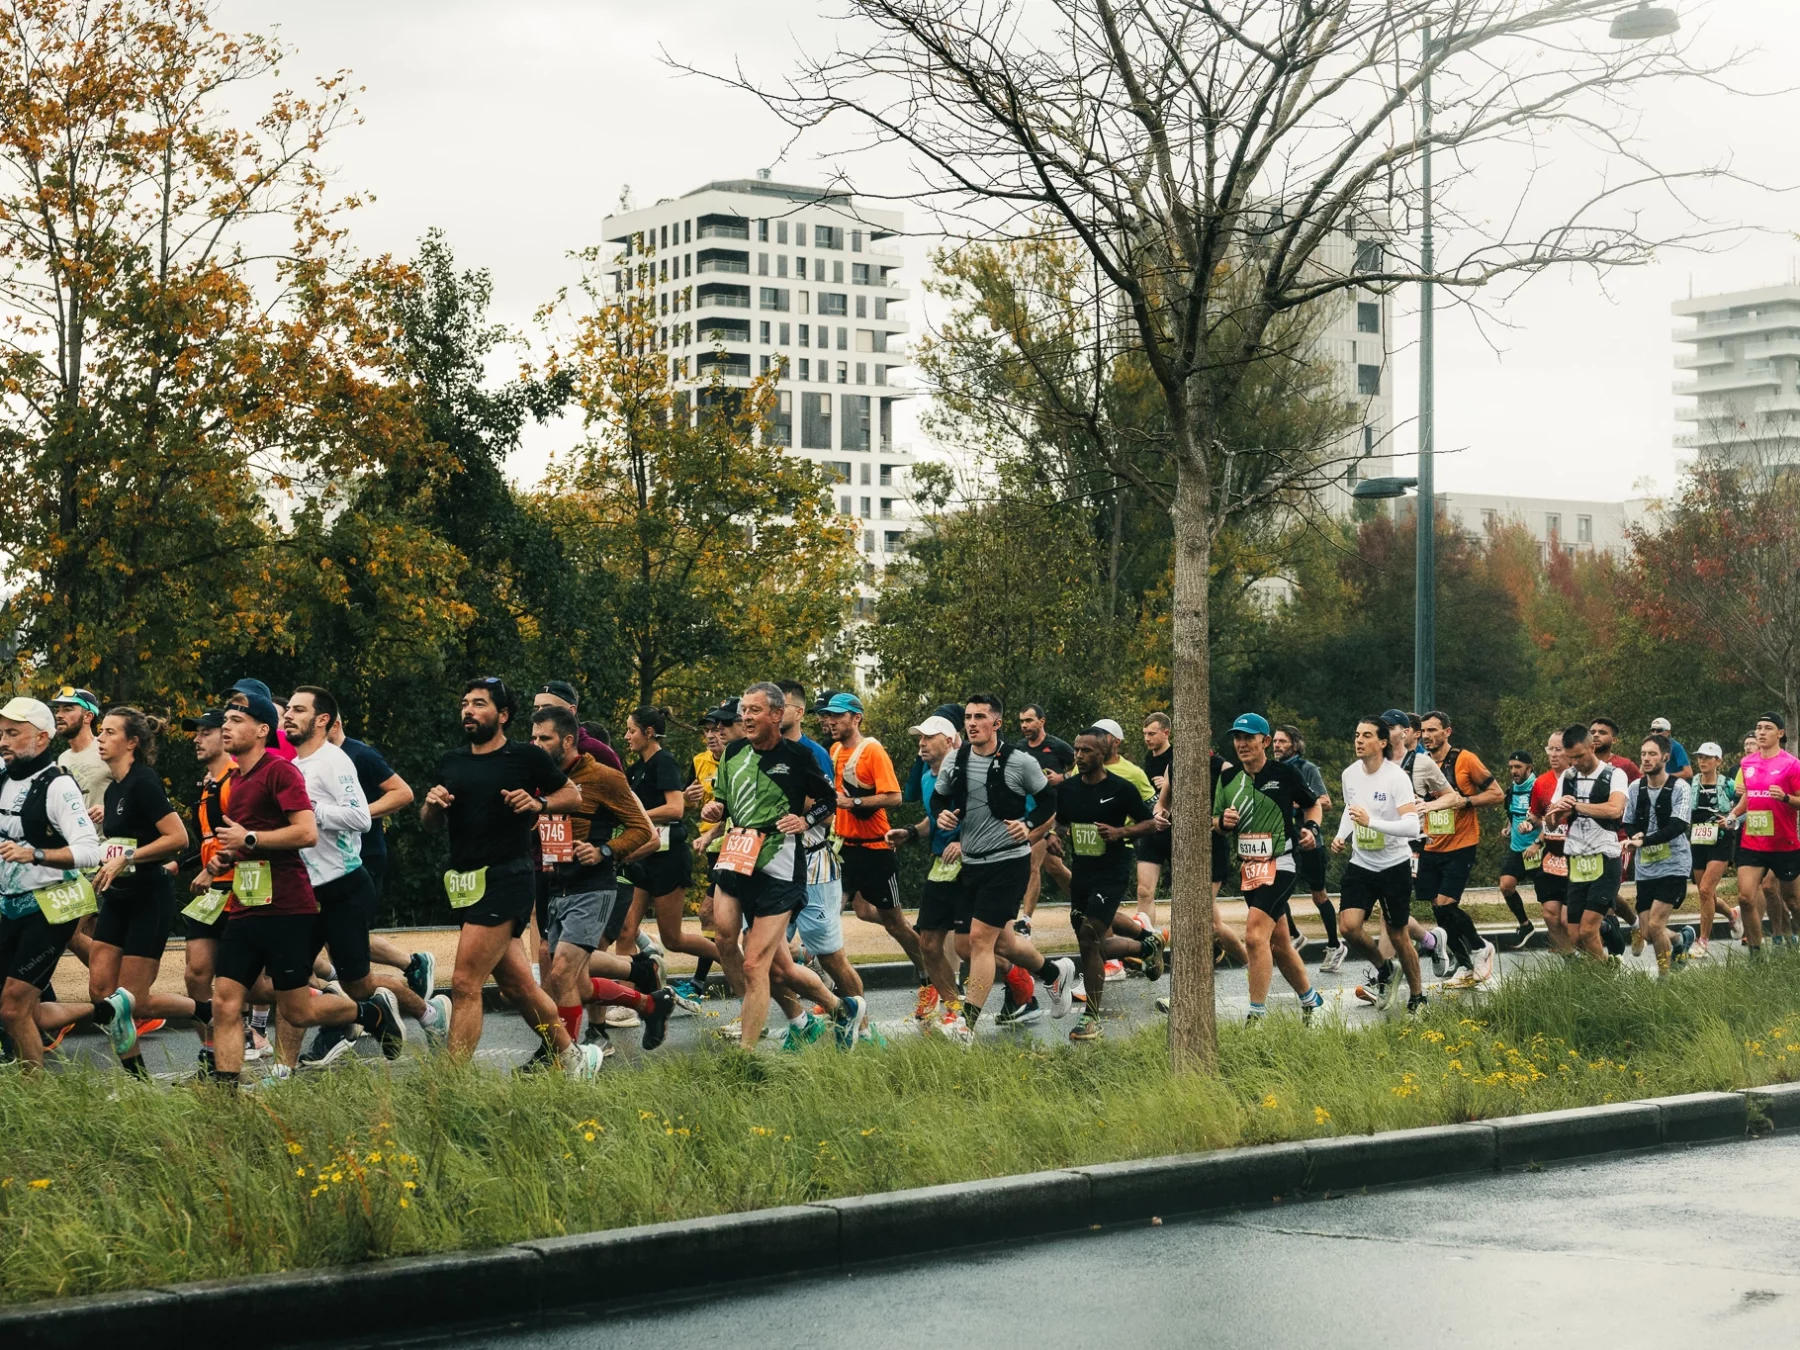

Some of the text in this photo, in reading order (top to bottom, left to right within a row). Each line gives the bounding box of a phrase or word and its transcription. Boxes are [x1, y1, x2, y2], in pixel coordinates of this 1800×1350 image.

[540, 823, 565, 842] 6746
[1076, 829, 1097, 845] 5712
[1694, 827, 1712, 838] 1295
[106, 845, 124, 859] 817
[726, 834, 754, 854] 6370
[1240, 841, 1267, 854] 6374-A
[1245, 862, 1268, 879] 6374
[1576, 857, 1597, 873] 4913
[450, 872, 476, 893] 5140
[47, 882, 85, 910] 3947
